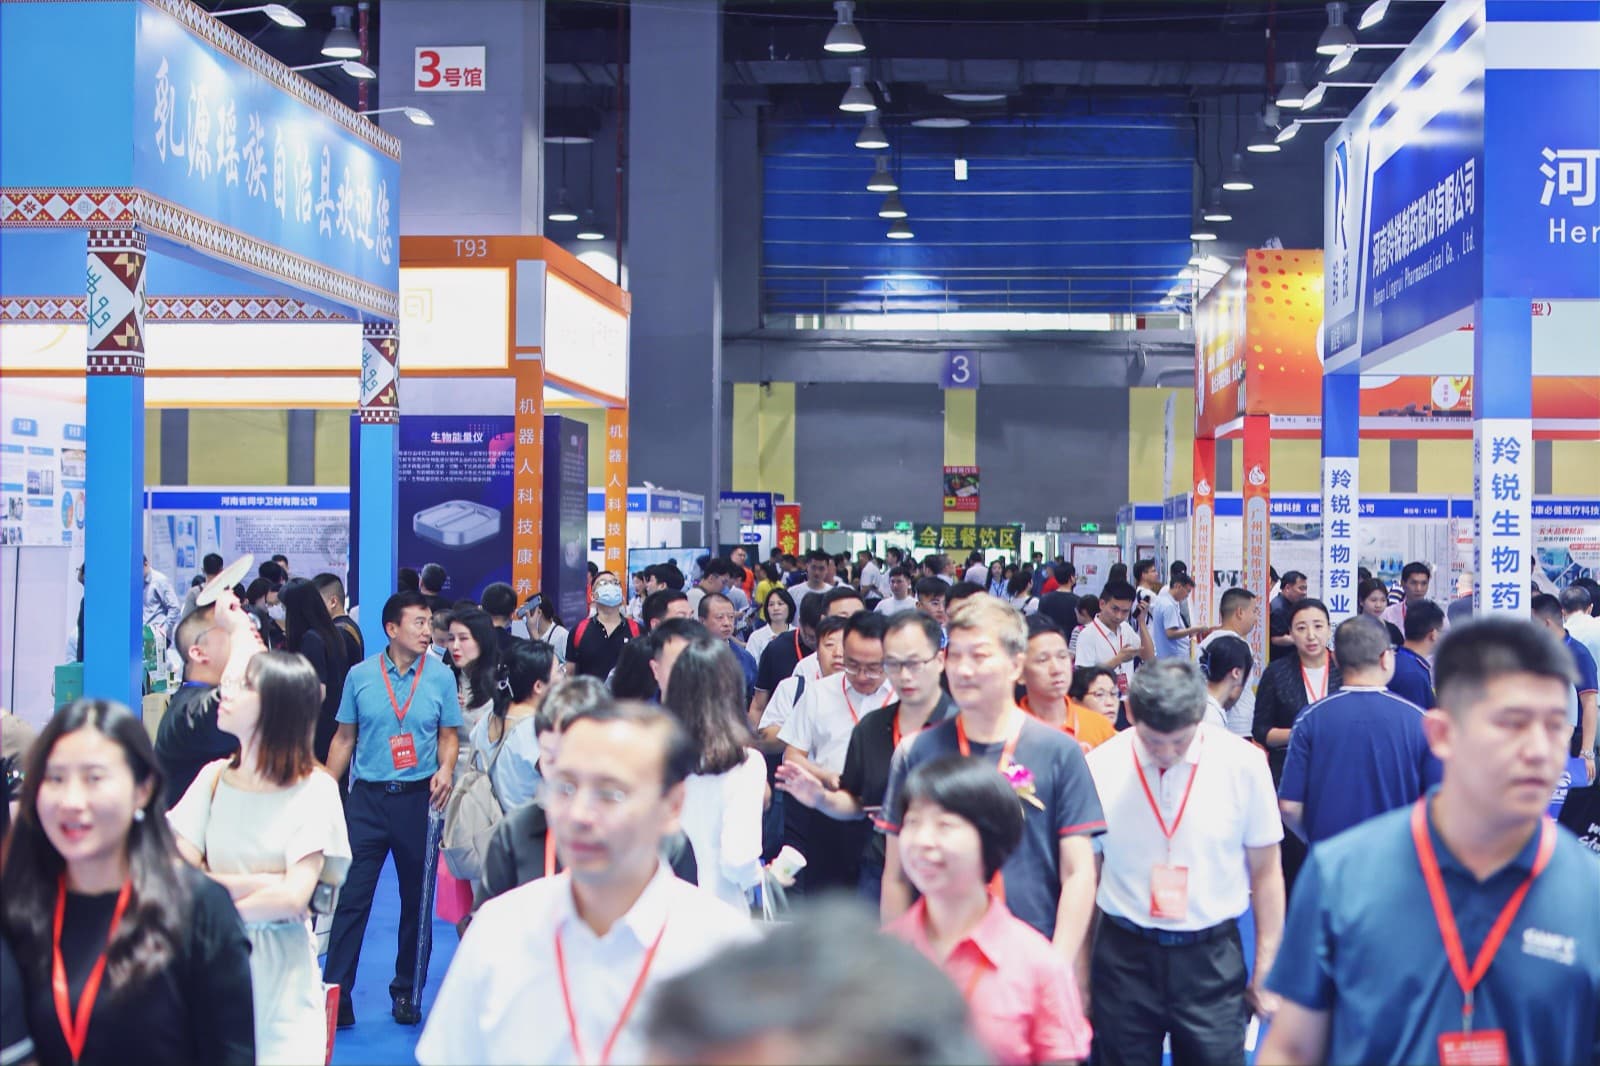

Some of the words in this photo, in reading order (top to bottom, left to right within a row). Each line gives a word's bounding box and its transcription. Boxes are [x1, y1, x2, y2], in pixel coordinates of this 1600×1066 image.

[417, 50, 483, 88] 3号馆
[153, 56, 392, 265] 乳源瑶族自治县欢迎您
[1372, 157, 1475, 280] 河南羚锐制药股份有限公司
[453, 239, 488, 257] T93
[1385, 270, 1404, 300] Lingrui
[1404, 247, 1444, 289] Pharmaceutical
[951, 355, 970, 384] 3
[430, 431, 484, 444] 生物能量仪
[516, 398, 536, 595] 机器人科技康养
[1491, 436, 1521, 610] 羚锐生物药
[919, 526, 1016, 549] 会展餐饮区
[1330, 469, 1352, 613] 羚锐生物药业
